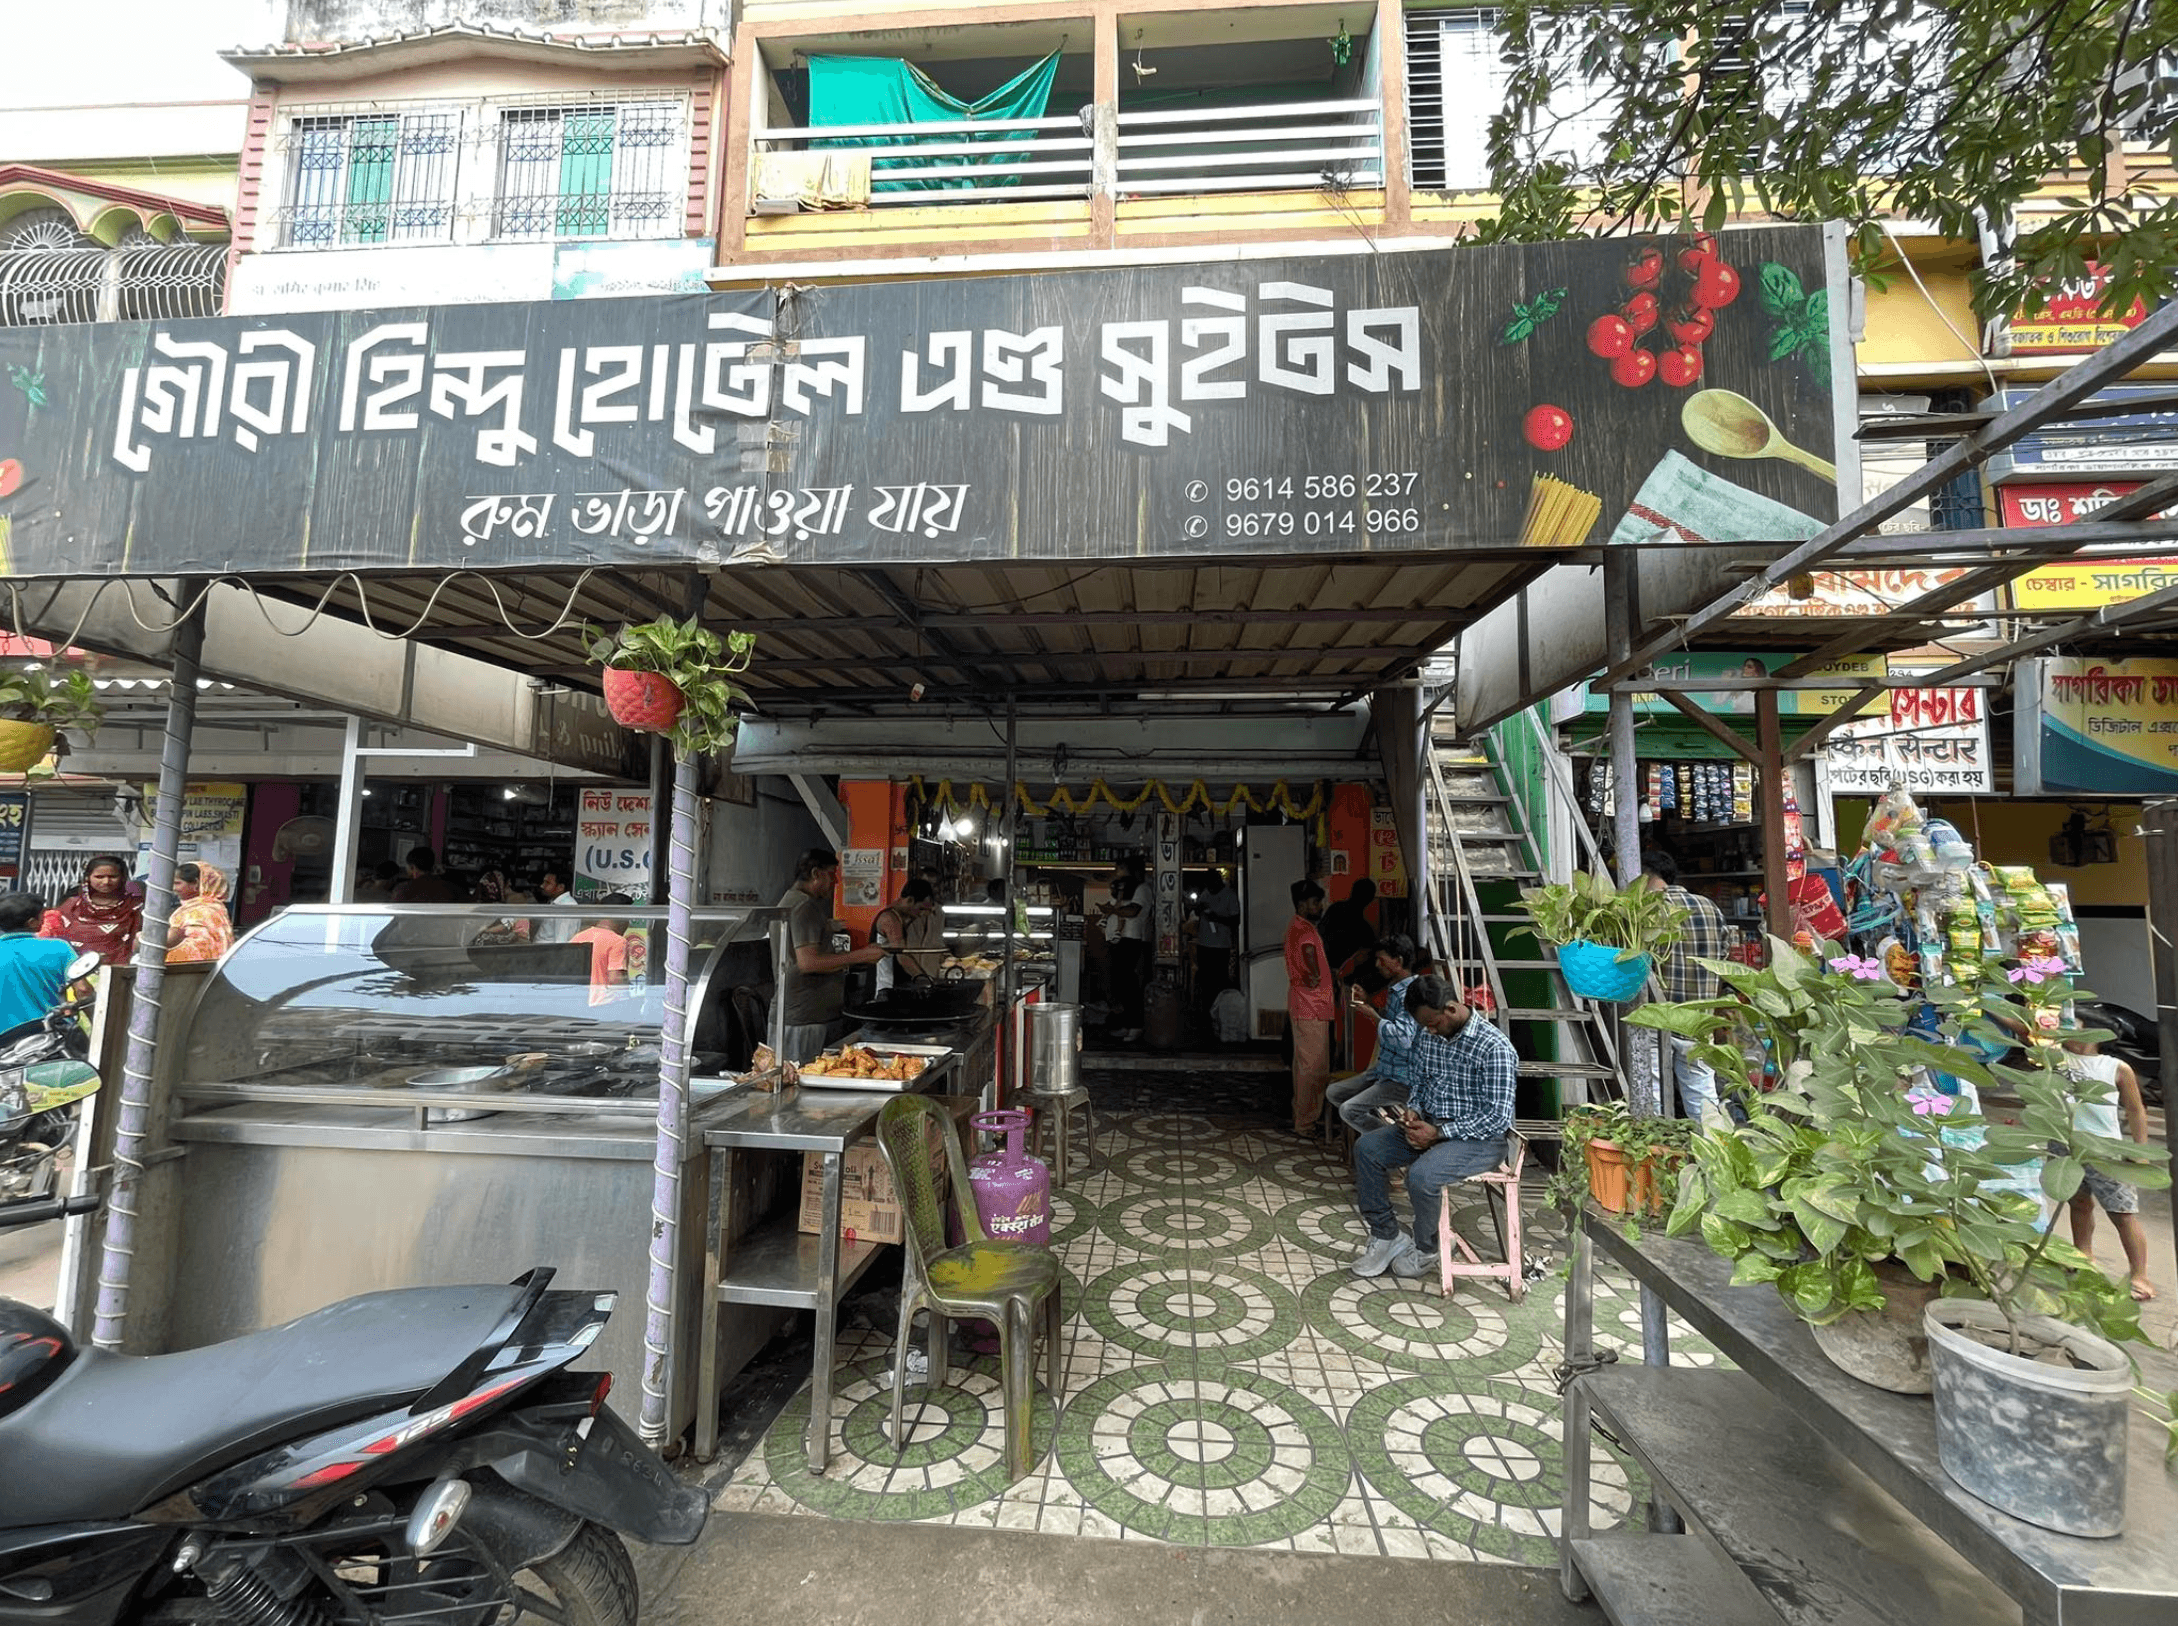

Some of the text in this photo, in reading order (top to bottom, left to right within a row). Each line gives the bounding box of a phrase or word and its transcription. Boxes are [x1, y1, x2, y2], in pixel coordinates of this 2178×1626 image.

[112, 331, 315, 471] গৌরী
[339, 323, 538, 466] হিন্দু
[552, 311, 865, 456] হোটেল
[1100, 281, 1421, 447] সুইটস
[1225, 472, 1419, 504] 9614 586 237
[461, 481, 971, 546] রুম ভাড়া পাওয়া যায়
[1225, 508, 1419, 537] 9679 014 966
[2018, 496, 2062, 524] ডাঃ
[1821, 695, 1854, 706] STO
[2088, 717, 2143, 735] ডিজিটাল
[1935, 770, 1960, 787] করা
[1962, 770, 1984, 788] হয়
[582, 789, 613, 813] নিউ
